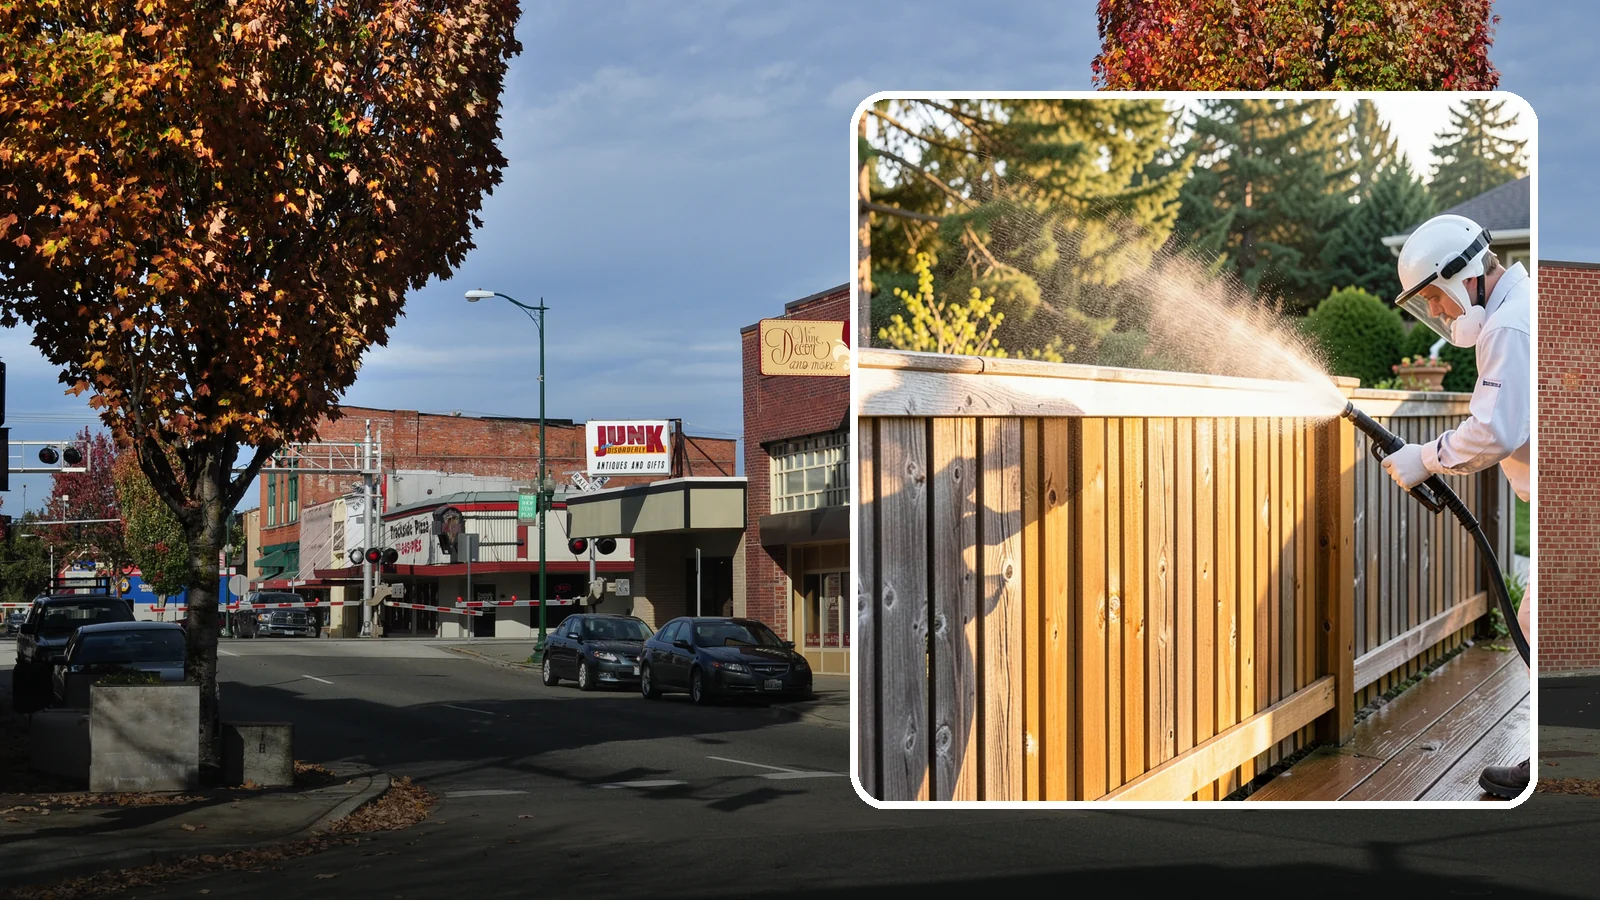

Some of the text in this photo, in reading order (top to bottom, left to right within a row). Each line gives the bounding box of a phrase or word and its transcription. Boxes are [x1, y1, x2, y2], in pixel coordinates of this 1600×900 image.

[596, 425, 665, 457] JUNK
[607, 446, 646, 454] DISORDERLY
[597, 460, 665, 470] ANTIQUES AND GIFTS
[414, 519, 429, 535] Pizza
